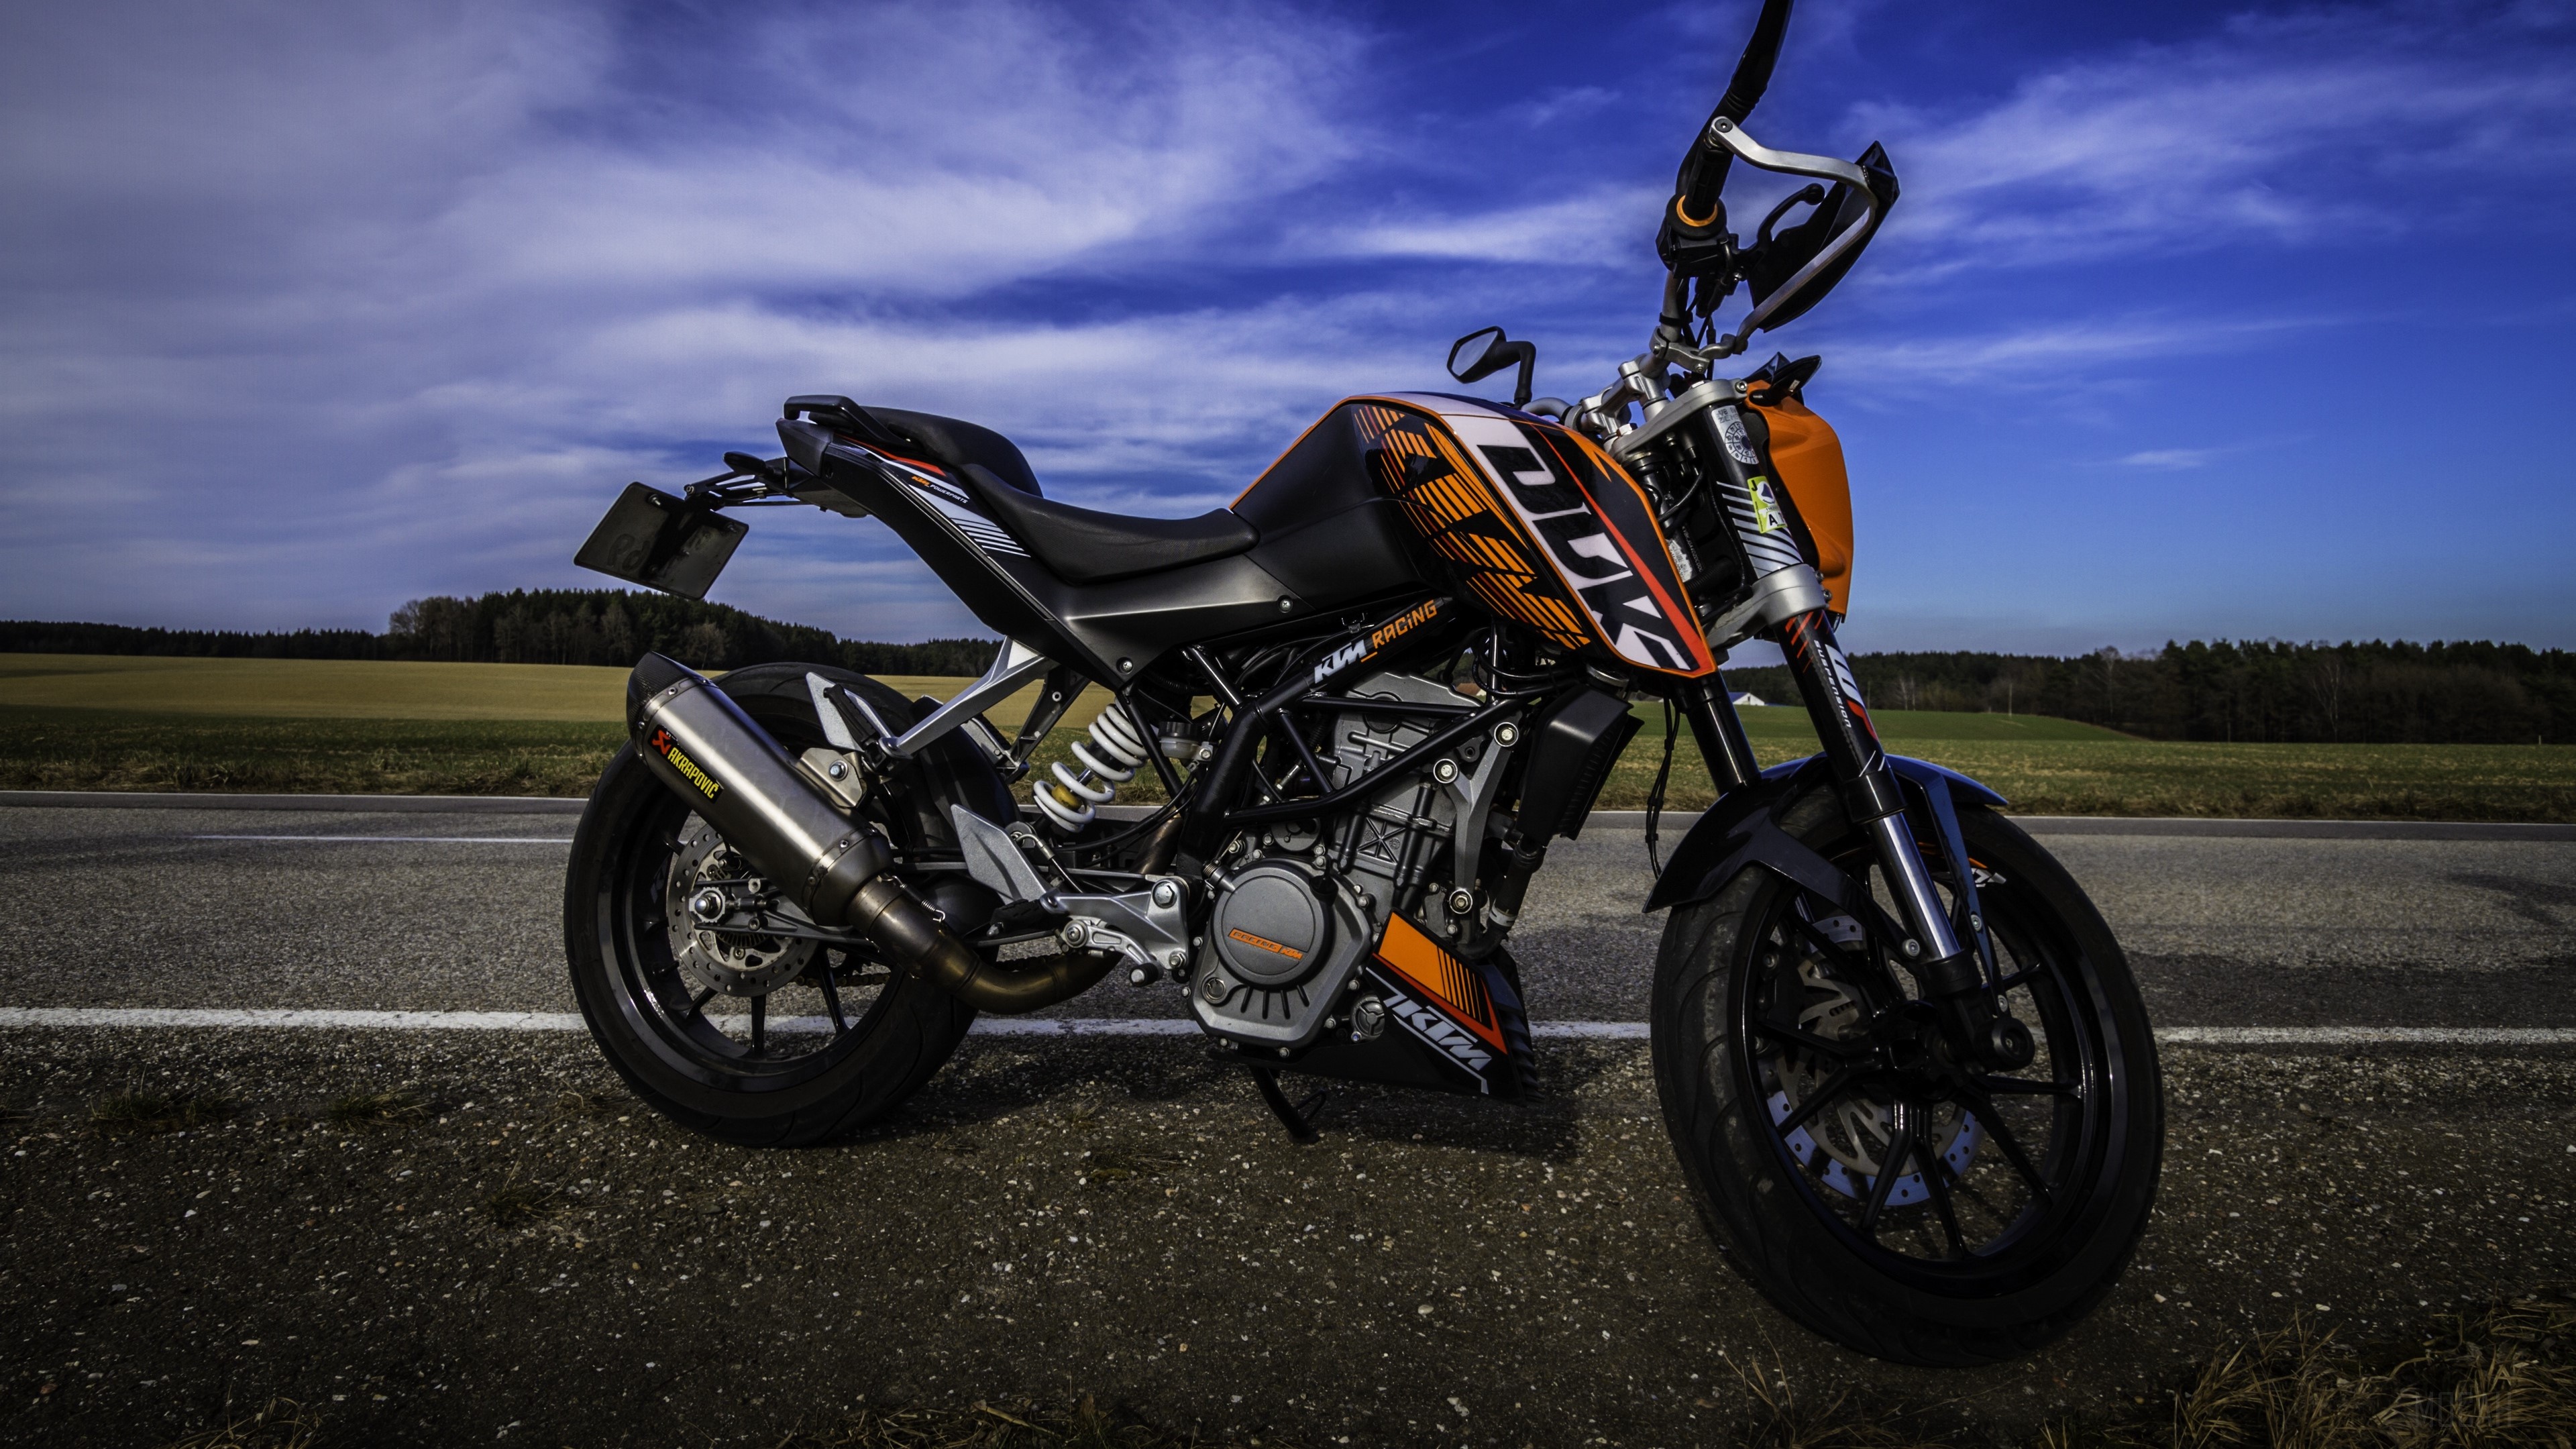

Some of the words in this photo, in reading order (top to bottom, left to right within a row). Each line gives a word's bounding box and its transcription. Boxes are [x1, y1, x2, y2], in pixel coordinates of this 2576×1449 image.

[1768, 514, 1778, 526] A
[1814, 639, 1851, 729] SUSPENSION
[1391, 998, 1493, 1071] KTM
